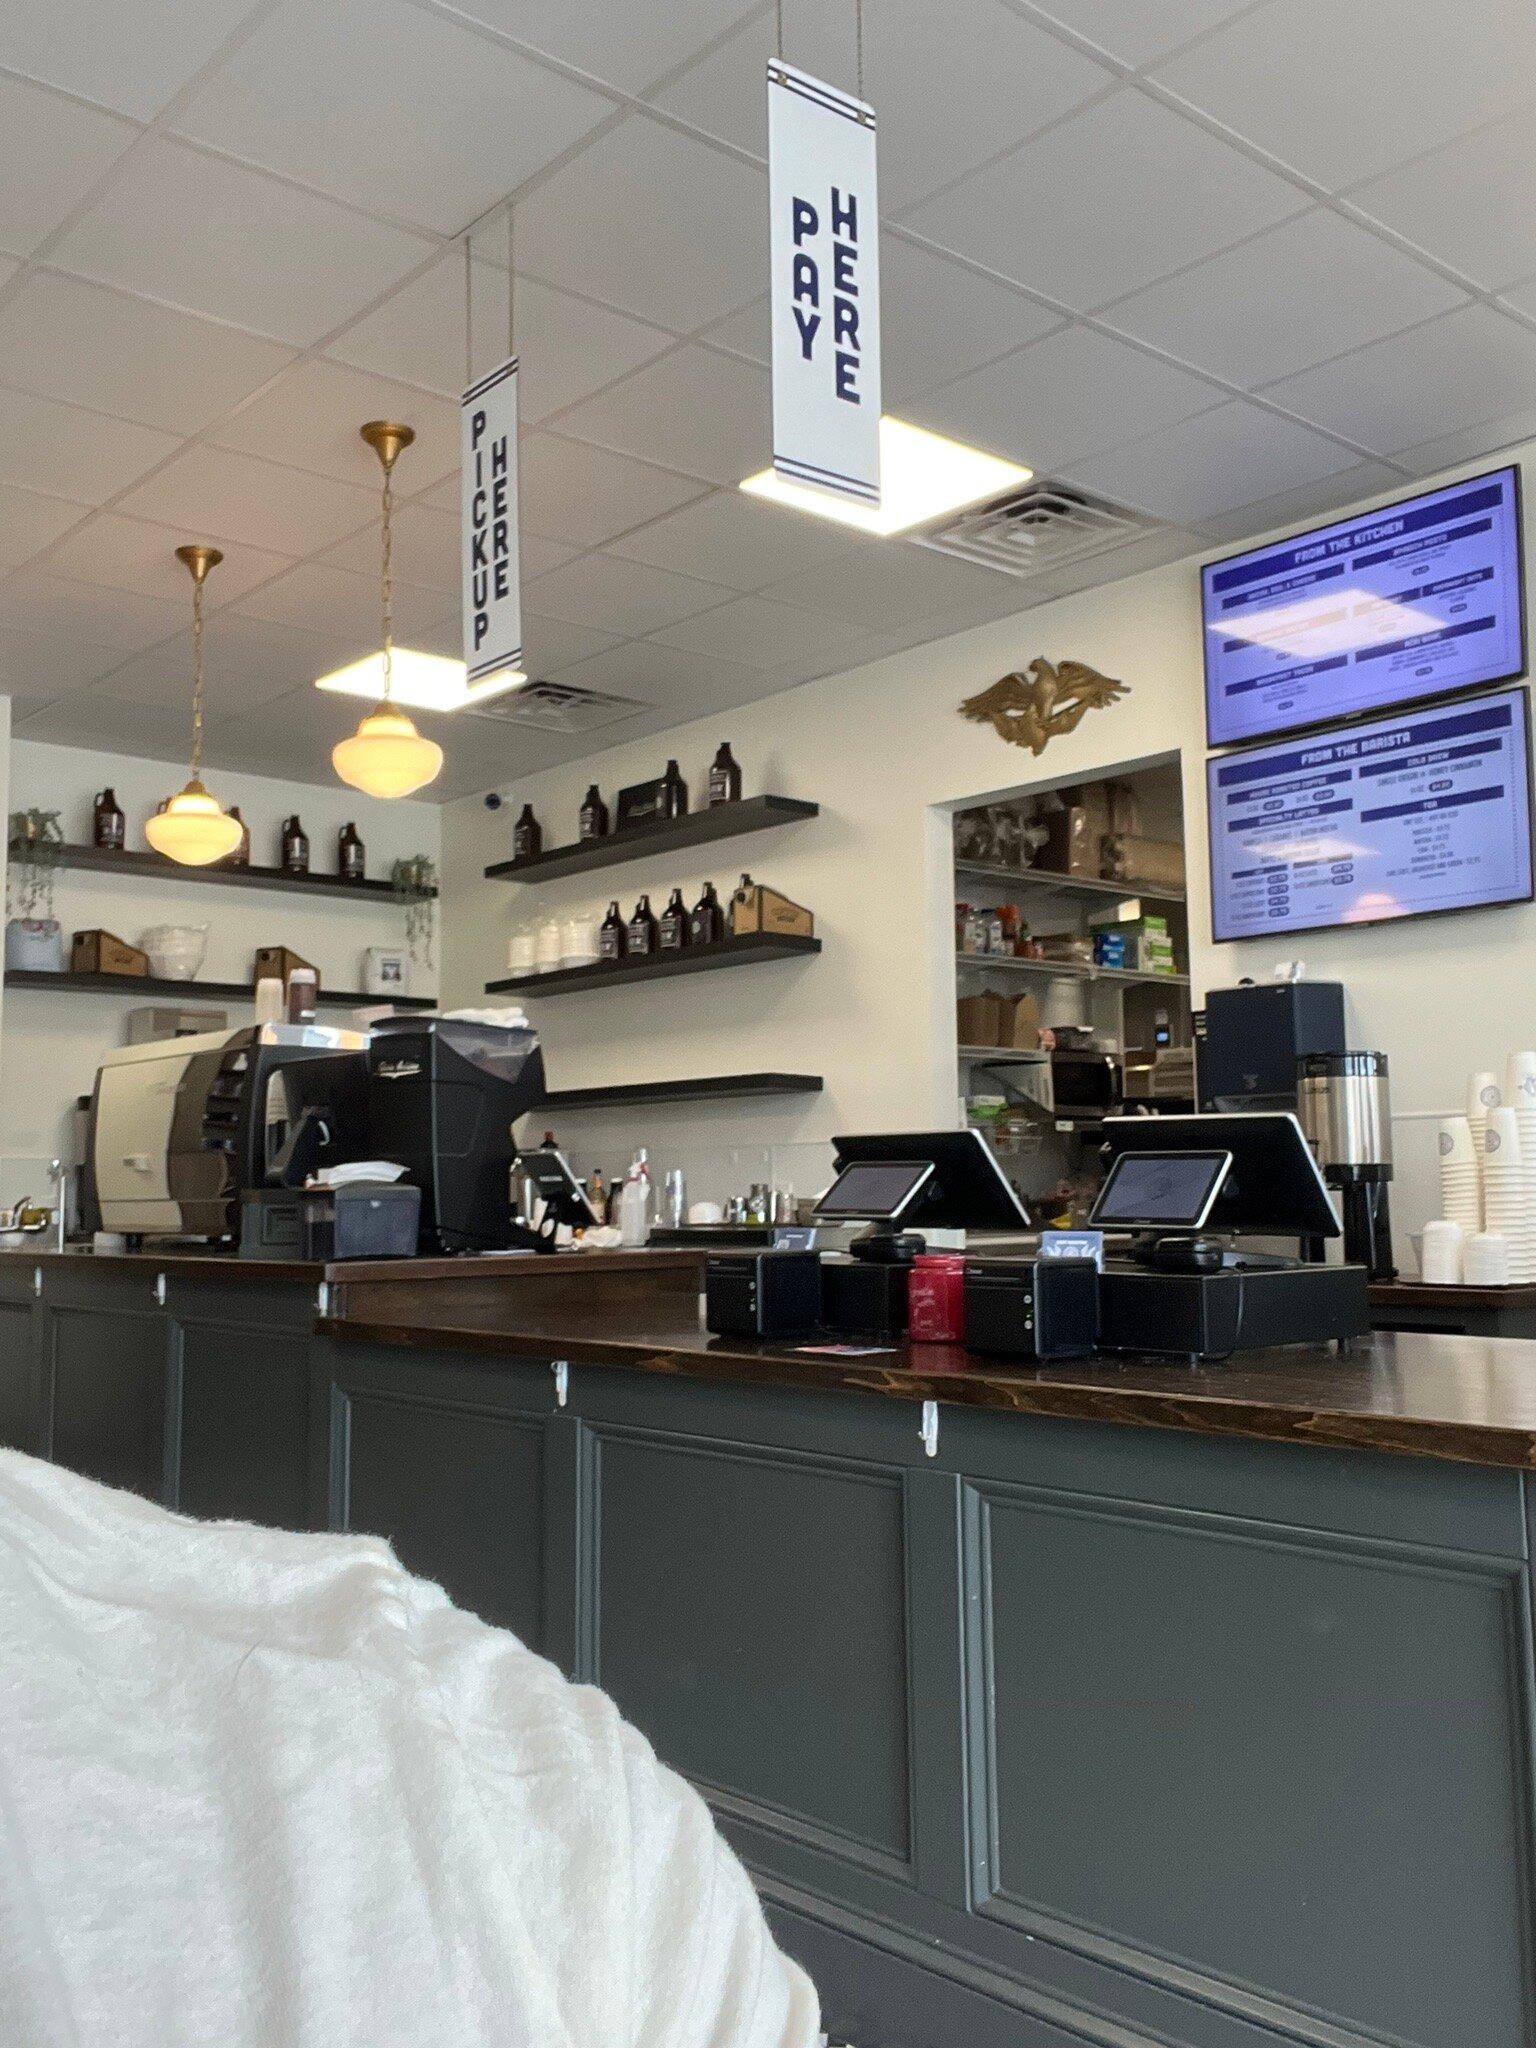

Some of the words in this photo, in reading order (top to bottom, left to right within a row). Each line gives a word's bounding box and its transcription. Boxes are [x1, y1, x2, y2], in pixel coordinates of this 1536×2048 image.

[791, 196, 821, 361] PAY
[831, 186, 862, 405] HERE
[471, 410, 488, 651] PICKUP
[491, 435, 509, 601] HERE
[1330, 536, 1350, 553] THE
[1354, 519, 1403, 545] KITCHEN
[1301, 748, 1332, 765] FROM
[1336, 742, 1357, 757] THE
[1361, 731, 1410, 752] BARISTA
